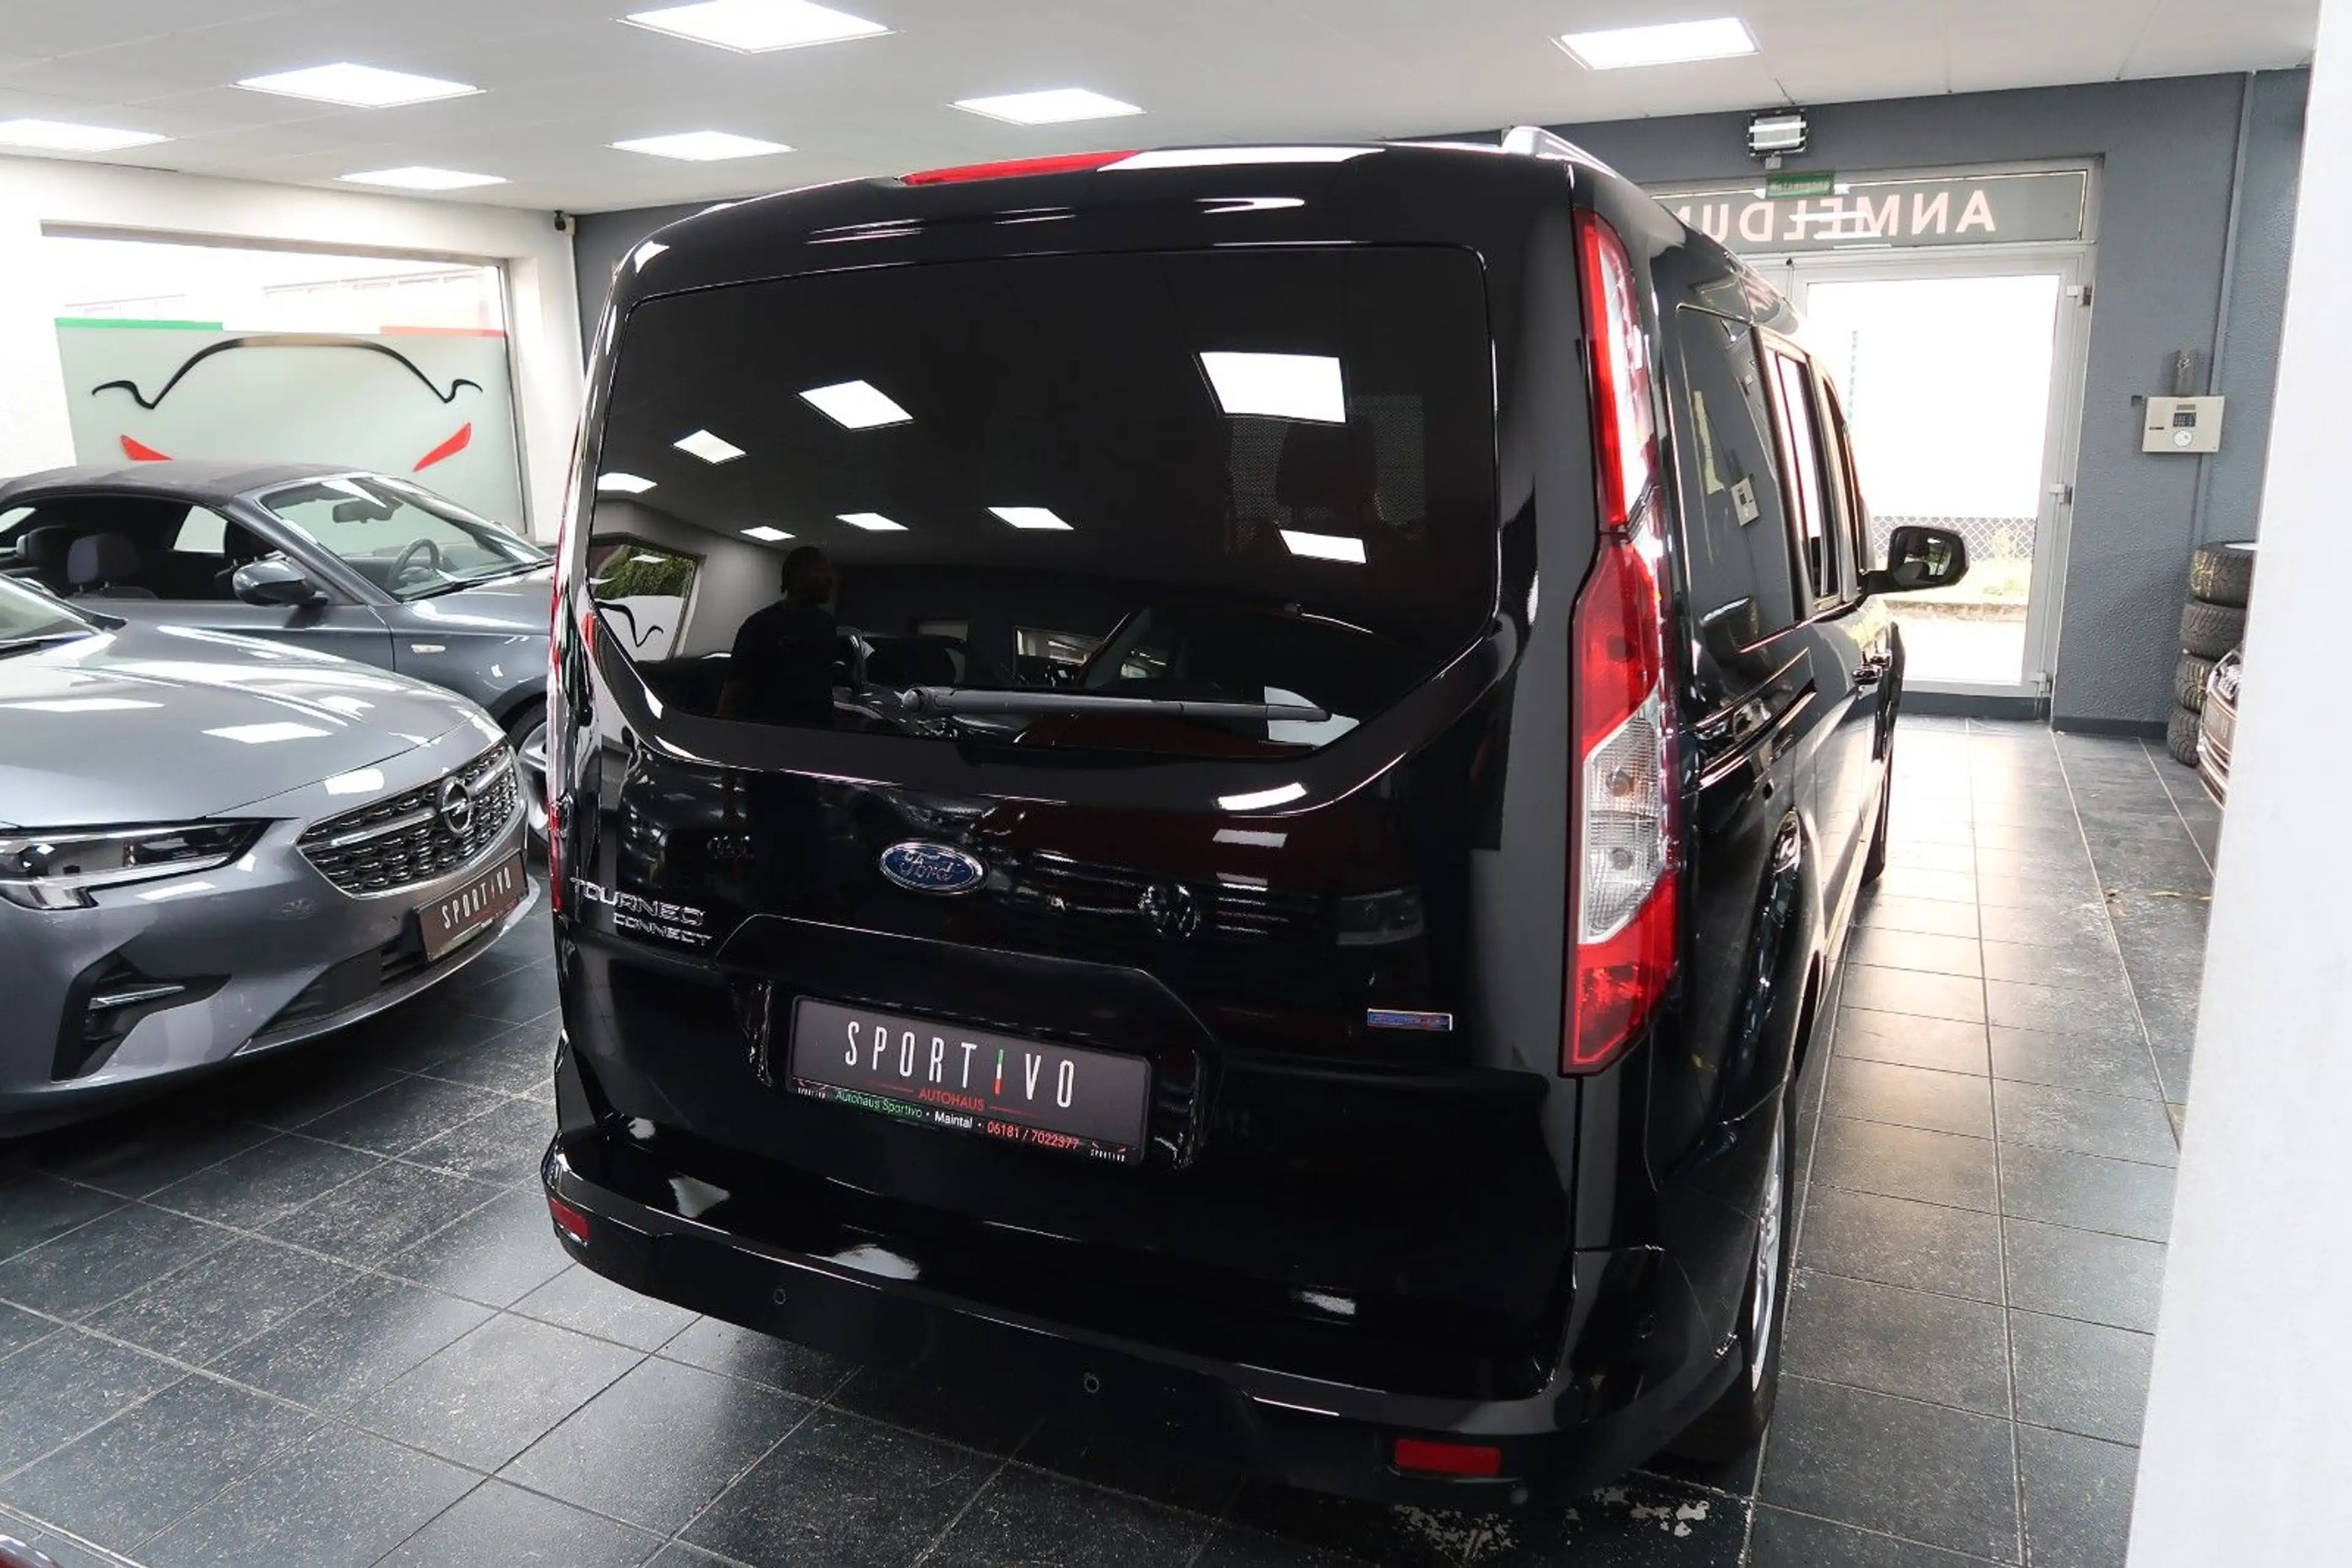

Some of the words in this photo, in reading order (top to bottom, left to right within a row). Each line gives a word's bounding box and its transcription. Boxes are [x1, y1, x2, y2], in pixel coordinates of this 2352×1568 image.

[899, 849, 954, 881] Ford
[570, 877, 706, 926] TOURNEO
[613, 912, 712, 946] CONNECT
[845, 1022, 1074, 1108] SPORTIVO
[835, 1090, 880, 1109] Autohaus
[882, 1098, 922, 1118] Sportivo
[934, 1110, 973, 1129] Maintal
[987, 1121, 1019, 1139] 06181
[918, 1088, 985, 1112] AUTOHAUS
